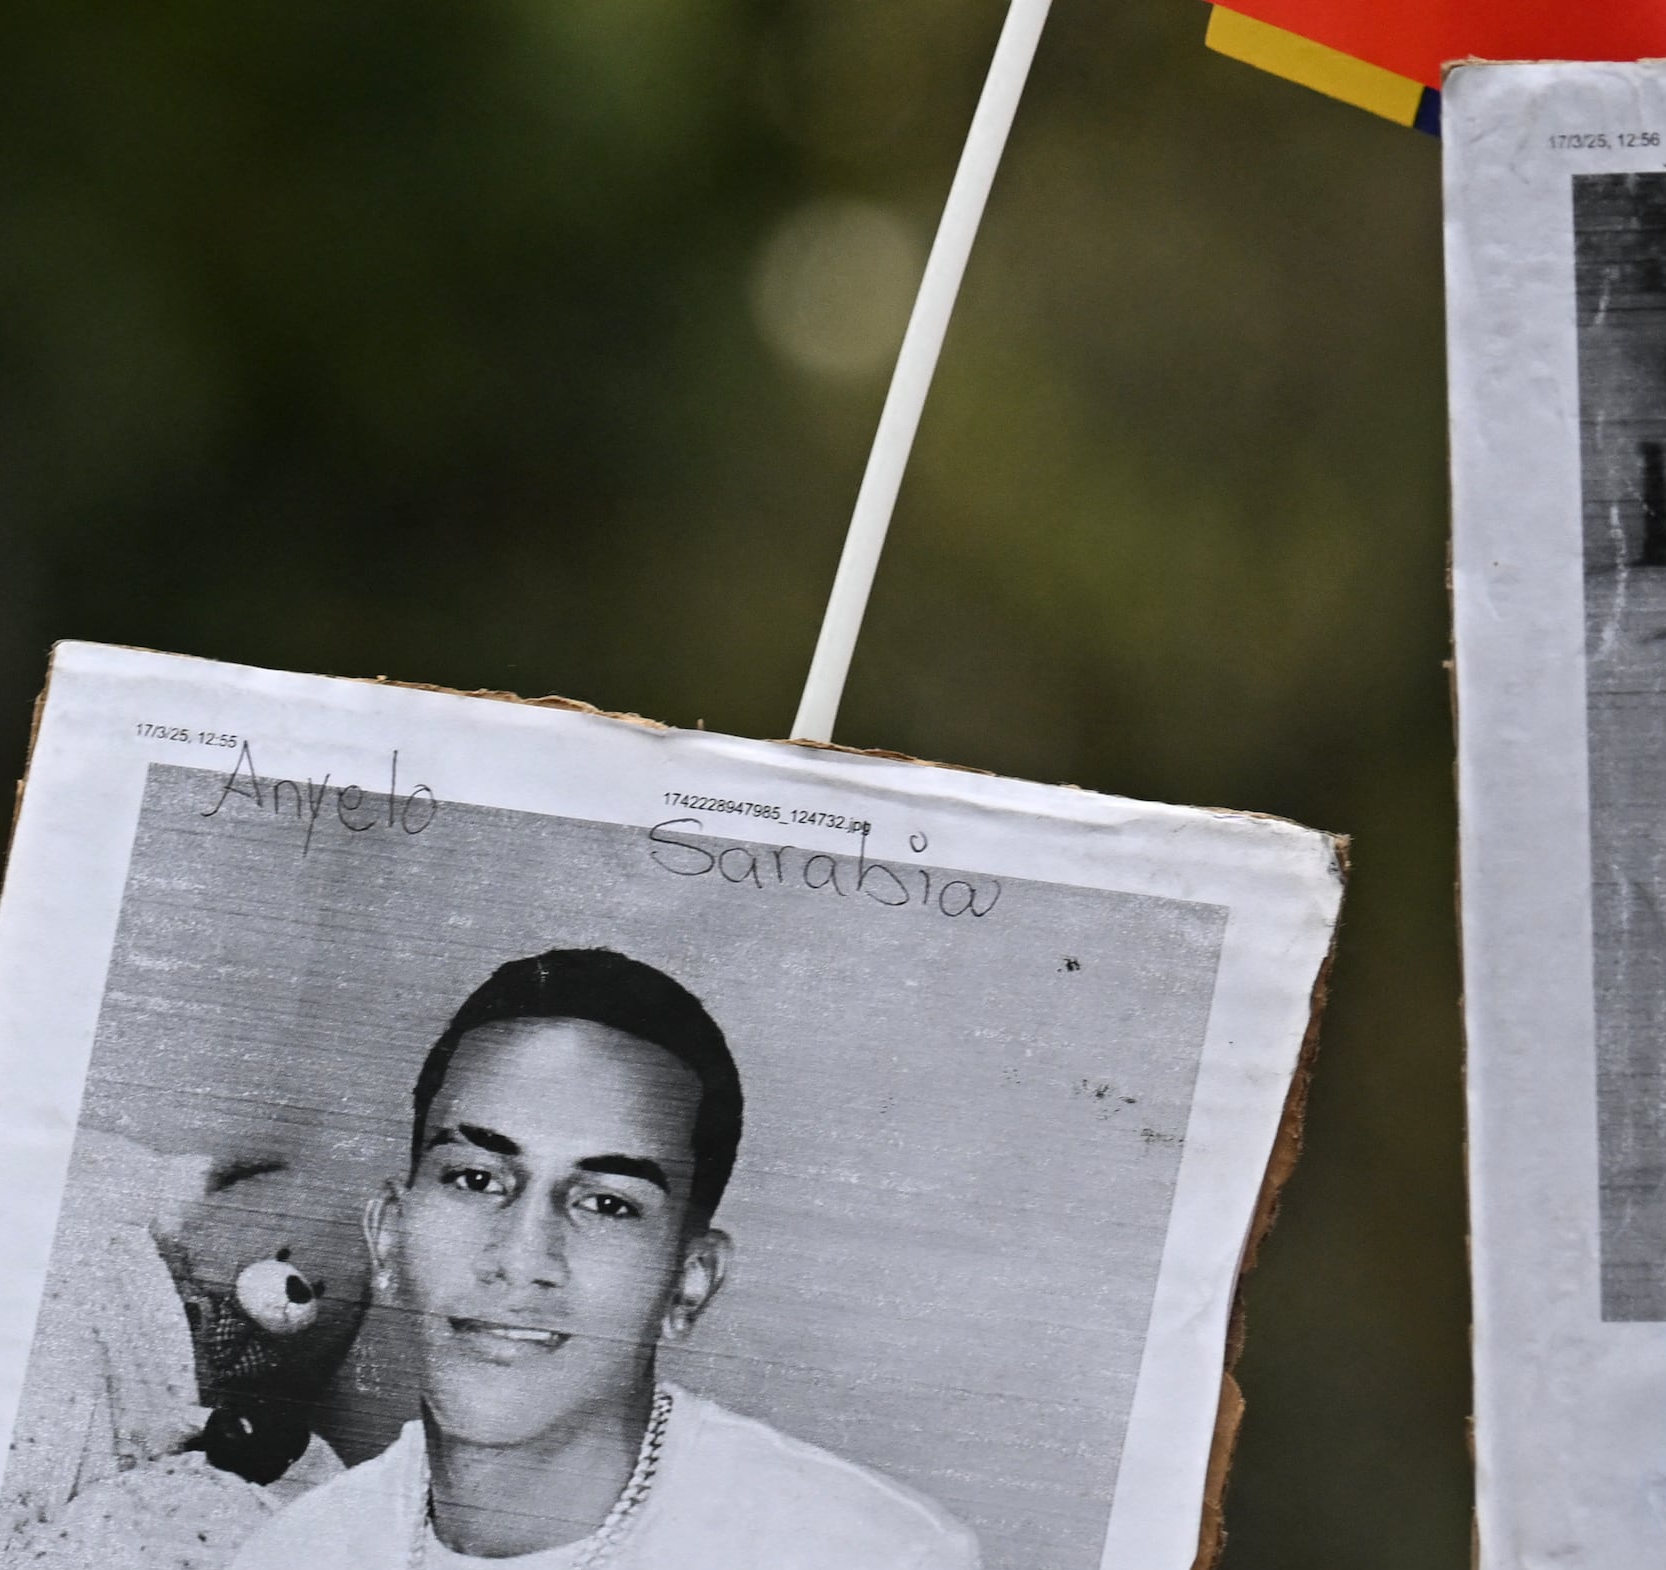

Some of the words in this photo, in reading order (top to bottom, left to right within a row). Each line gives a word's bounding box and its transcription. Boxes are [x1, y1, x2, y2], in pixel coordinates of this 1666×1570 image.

[134, 722, 192, 745] 17/3/25,
[197, 730, 239, 750] 12:55
[200, 739, 439, 858] Anyelo
[648, 817, 1003, 918] Sarabia
